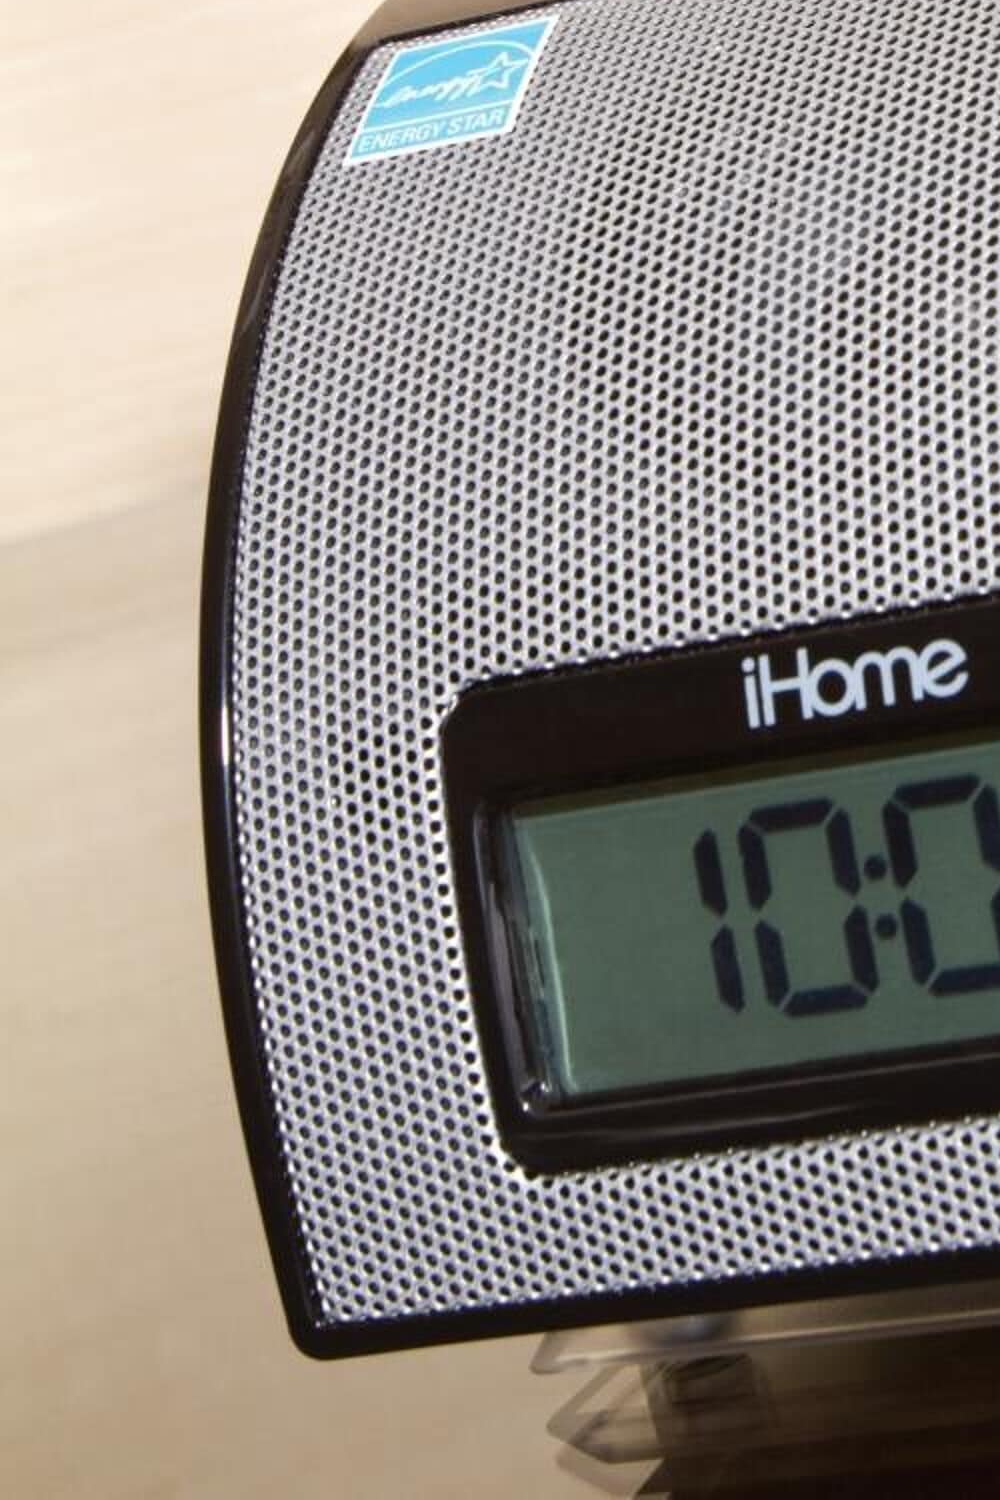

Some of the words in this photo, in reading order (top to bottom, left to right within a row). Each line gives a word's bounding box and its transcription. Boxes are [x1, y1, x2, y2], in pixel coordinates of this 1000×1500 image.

[358, 123, 443, 152] ENERGY
[447, 110, 505, 135] STAR
[741, 638, 969, 729] iHome
